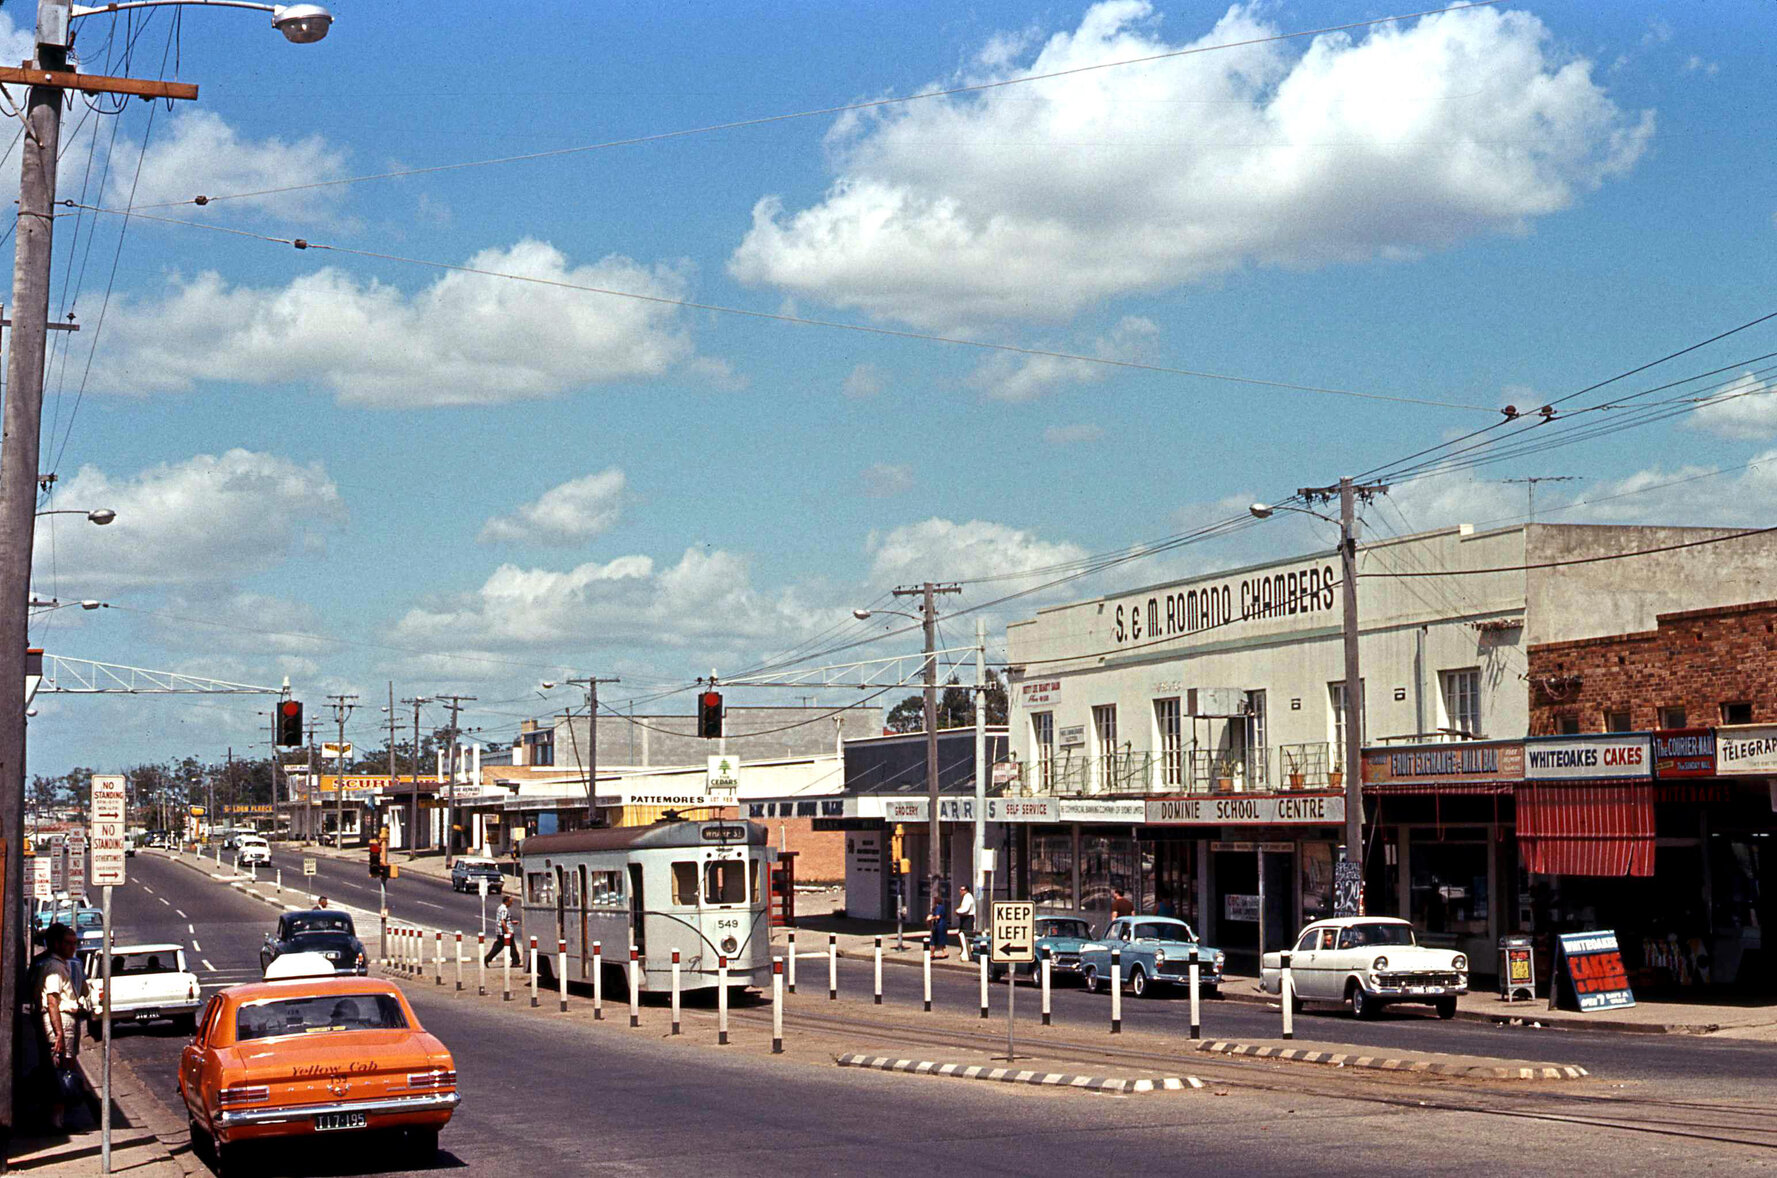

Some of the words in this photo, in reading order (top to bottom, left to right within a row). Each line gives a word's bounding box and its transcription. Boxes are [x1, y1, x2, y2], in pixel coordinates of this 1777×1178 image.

[1132, 606, 1142, 640] &
[1167, 584, 1231, 635] ROMANO
[1241, 565, 1334, 622] CHAMBERS
[1391, 752, 1414, 777] FRUIT
[1415, 751, 1456, 776] EXCHANGE
[1461, 749, 1481, 774] MILK
[1482, 749, 1498, 773] BAR
[1529, 749, 1597, 768] WHITEOAKES
[1603, 747, 1642, 766] CAKES
[94, 791, 123, 799] STANDING
[631, 795, 705, 804] PATTEMORES
[223, 805, 249, 813] GLDEN
[895, 805, 918, 816] GROCERY
[928, 801, 996, 820] ARRS
[1006, 804, 1019, 815] SELF
[1022, 803, 1047, 815] SERVICE
[1161, 801, 1200, 819] DOMINIE
[1217, 799, 1260, 819] SCHOOL
[1278, 798, 1325, 819] CENTRE
[102, 825, 115, 836] NO
[94, 839, 123, 850] STANDING
[997, 906, 1030, 920] KEEP
[718, 920, 739, 928] 549
[999, 926, 1028, 940] LEFT
[1563, 936, 1619, 953] WHITEOAKES
[1568, 951, 1624, 980] CAKES
[292, 1065, 341, 1077] Yellow
[350, 1061, 378, 1072] Cab
